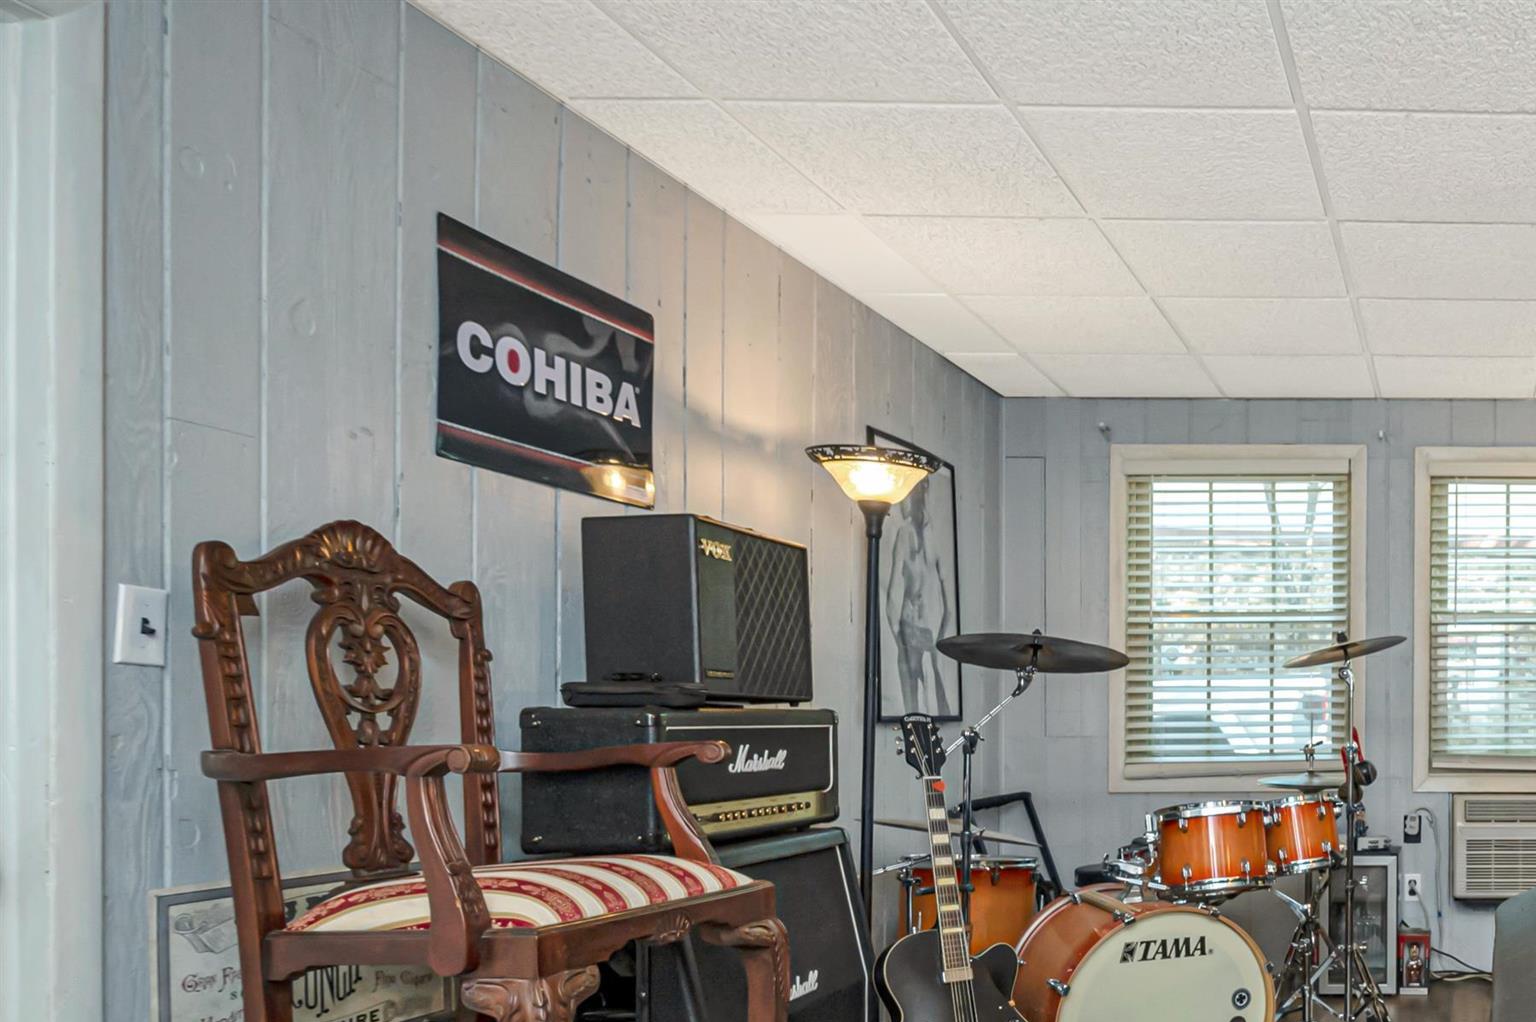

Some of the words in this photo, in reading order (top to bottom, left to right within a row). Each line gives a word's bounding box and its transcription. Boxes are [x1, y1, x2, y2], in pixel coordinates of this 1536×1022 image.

[456, 320, 642, 428] COHIBA
[699, 537, 733, 562] VOX
[728, 743, 788, 774] Marshall
[1137, 935, 1207, 962] TAMA
